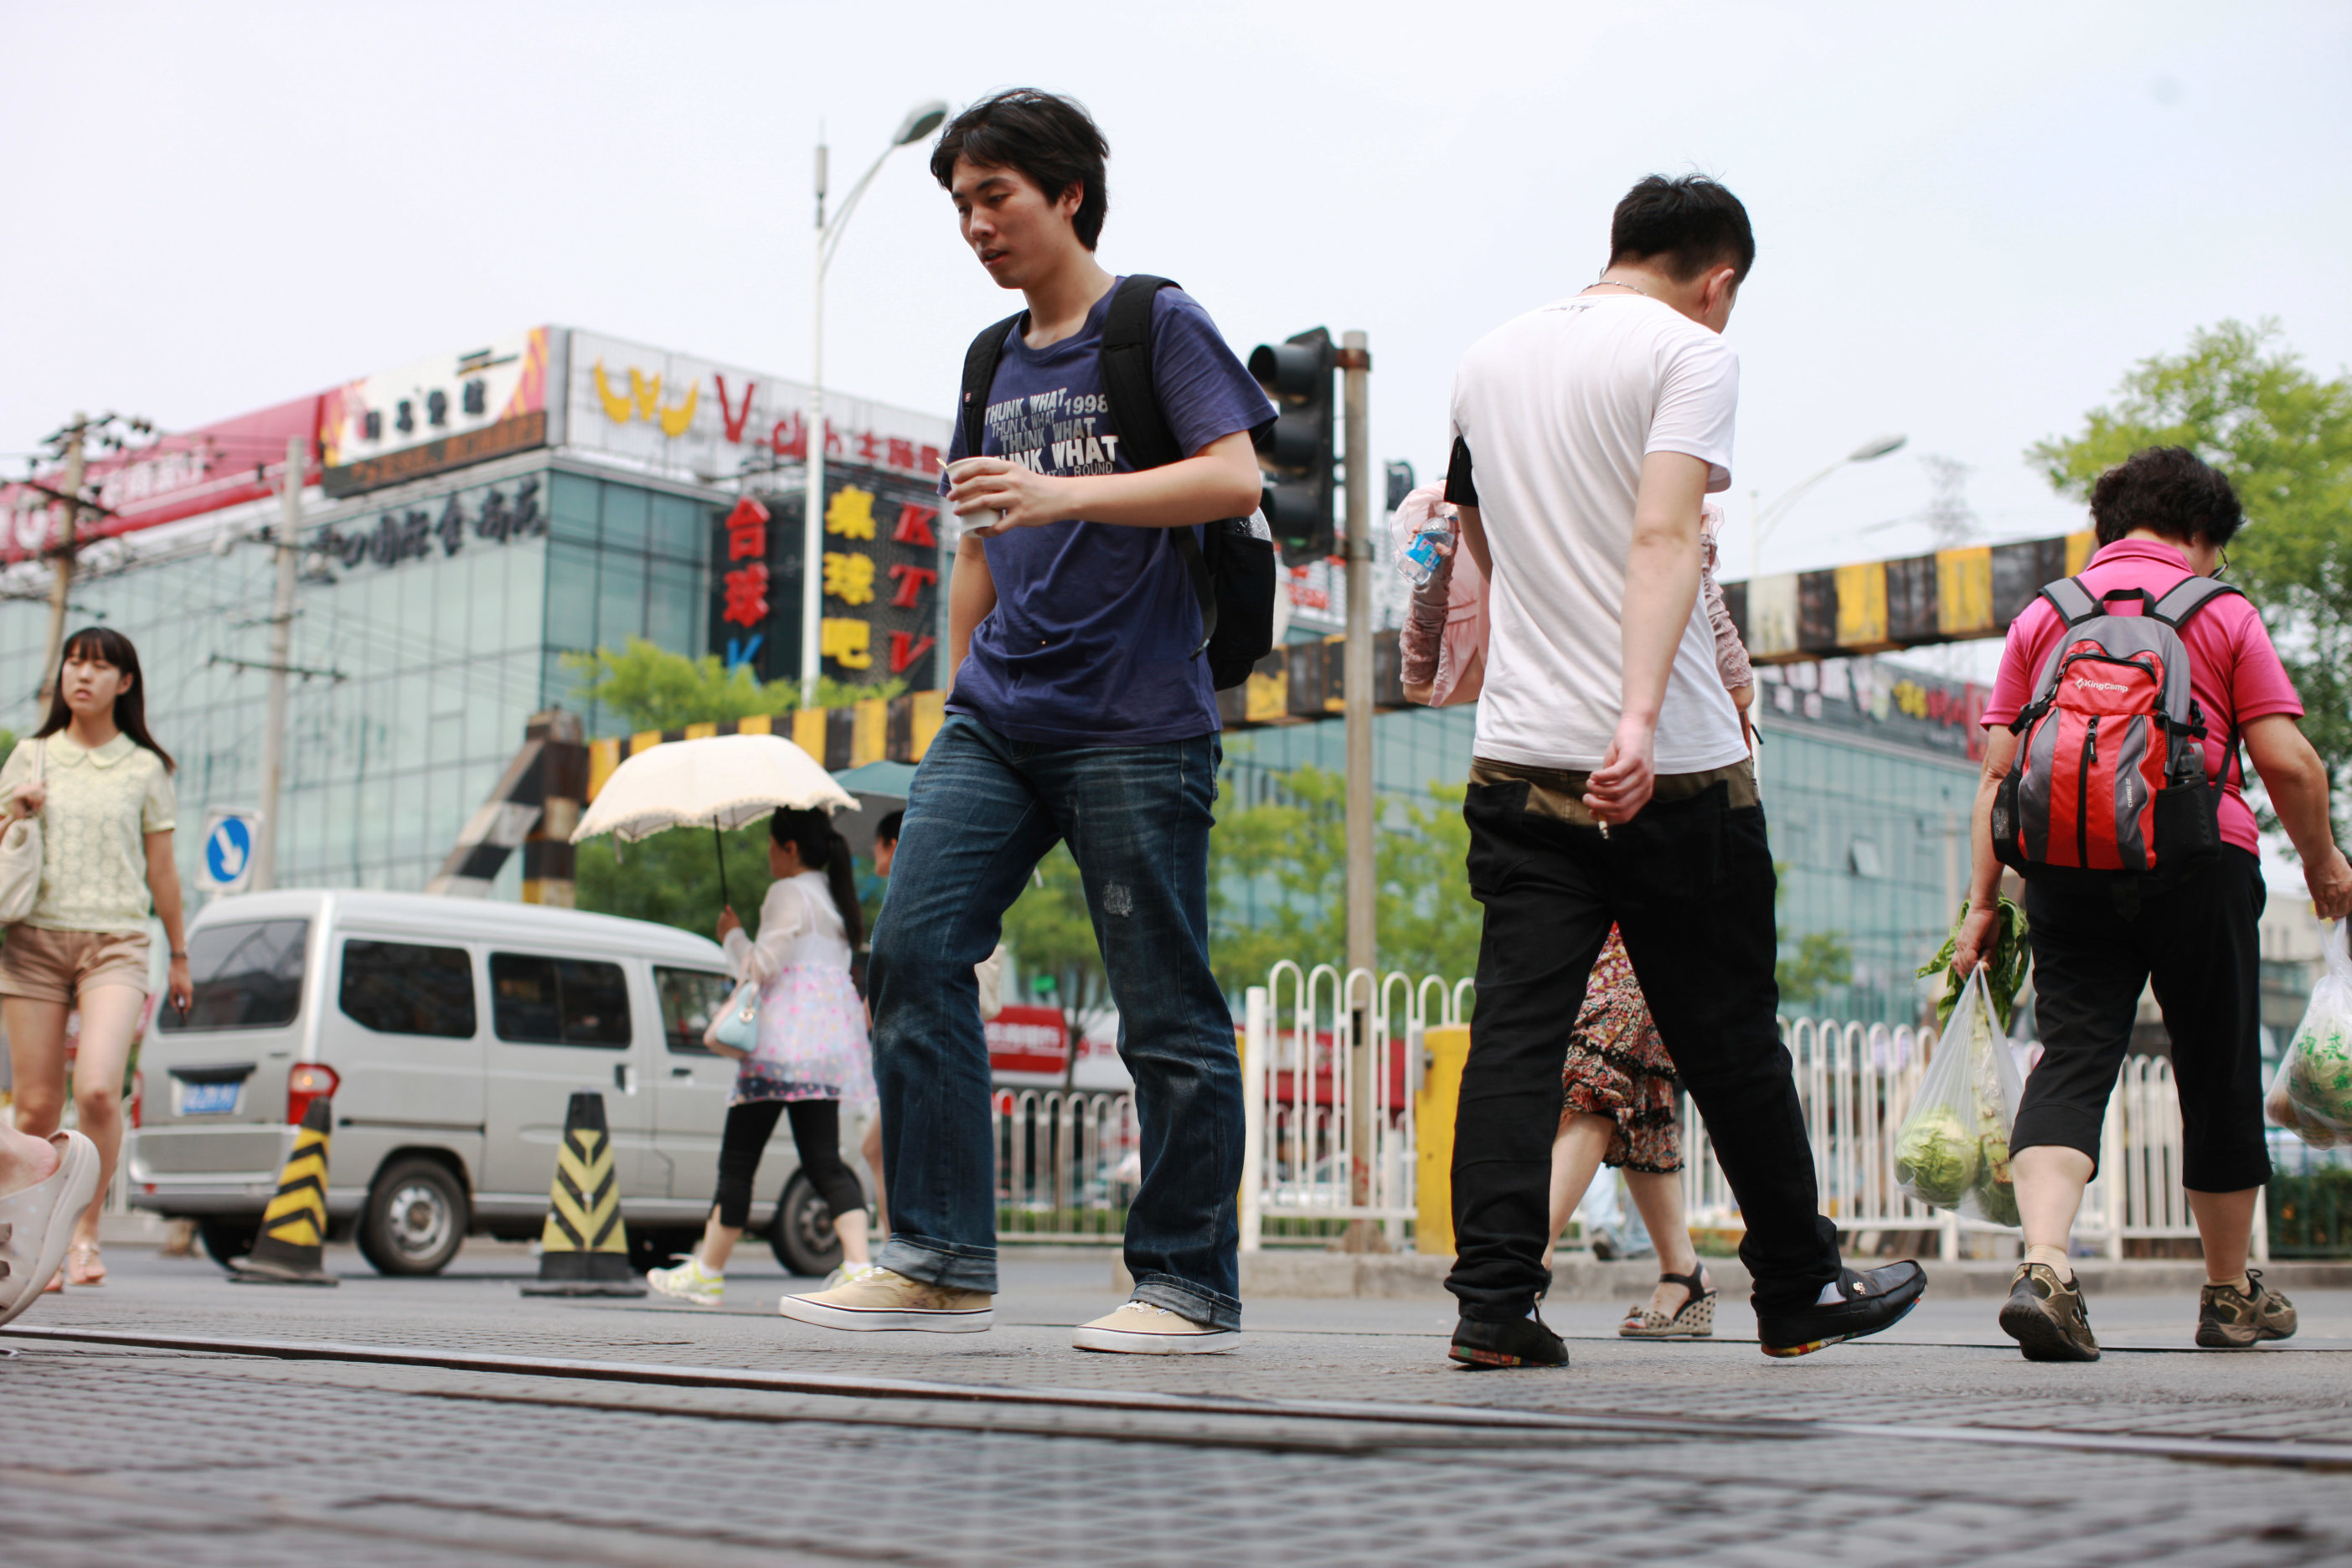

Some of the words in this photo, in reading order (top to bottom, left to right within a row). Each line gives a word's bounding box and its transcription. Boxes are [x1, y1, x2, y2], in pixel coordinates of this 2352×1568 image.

[985, 398, 1024, 426] THUNK
[1029, 387, 1067, 415] WHAT
[1064, 394, 1109, 416] 1998
[1030, 409, 1056, 430] WHAT
[1000, 427, 1046, 455] THUNK
[1053, 416, 1096, 442] WHAT
[1051, 435, 1119, 470] WHAT
[1073, 461, 1113, 477] ROUND
[889, 502, 940, 673] KTV
[2084, 679, 2129, 693] KingCamp
